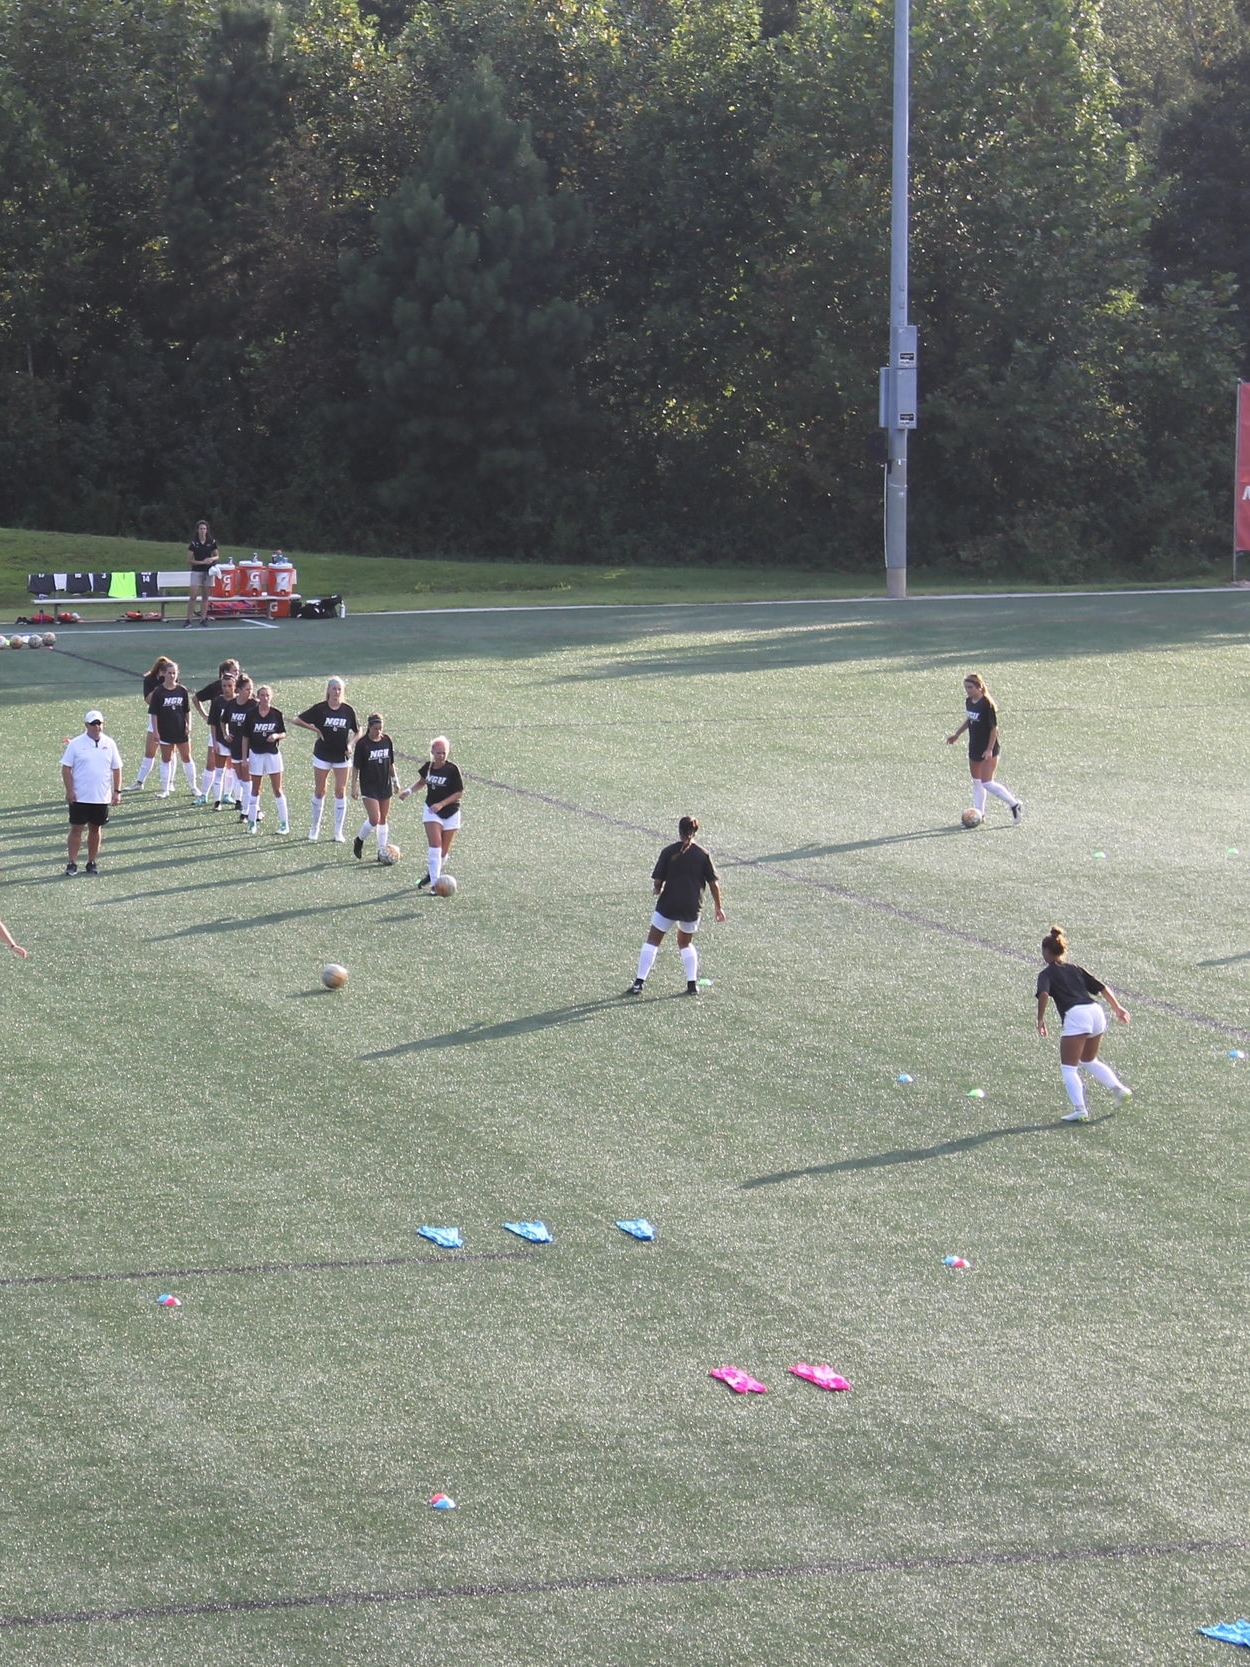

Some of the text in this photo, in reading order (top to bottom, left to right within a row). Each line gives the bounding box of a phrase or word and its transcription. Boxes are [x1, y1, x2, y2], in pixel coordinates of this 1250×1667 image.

[223, 575, 231, 583] G
[250, 572, 259, 581] G
[270, 602, 278, 612] G
[325, 718, 347, 726] NGU
[253, 723, 275, 731] NGU
[370, 749, 389, 758] NGU
